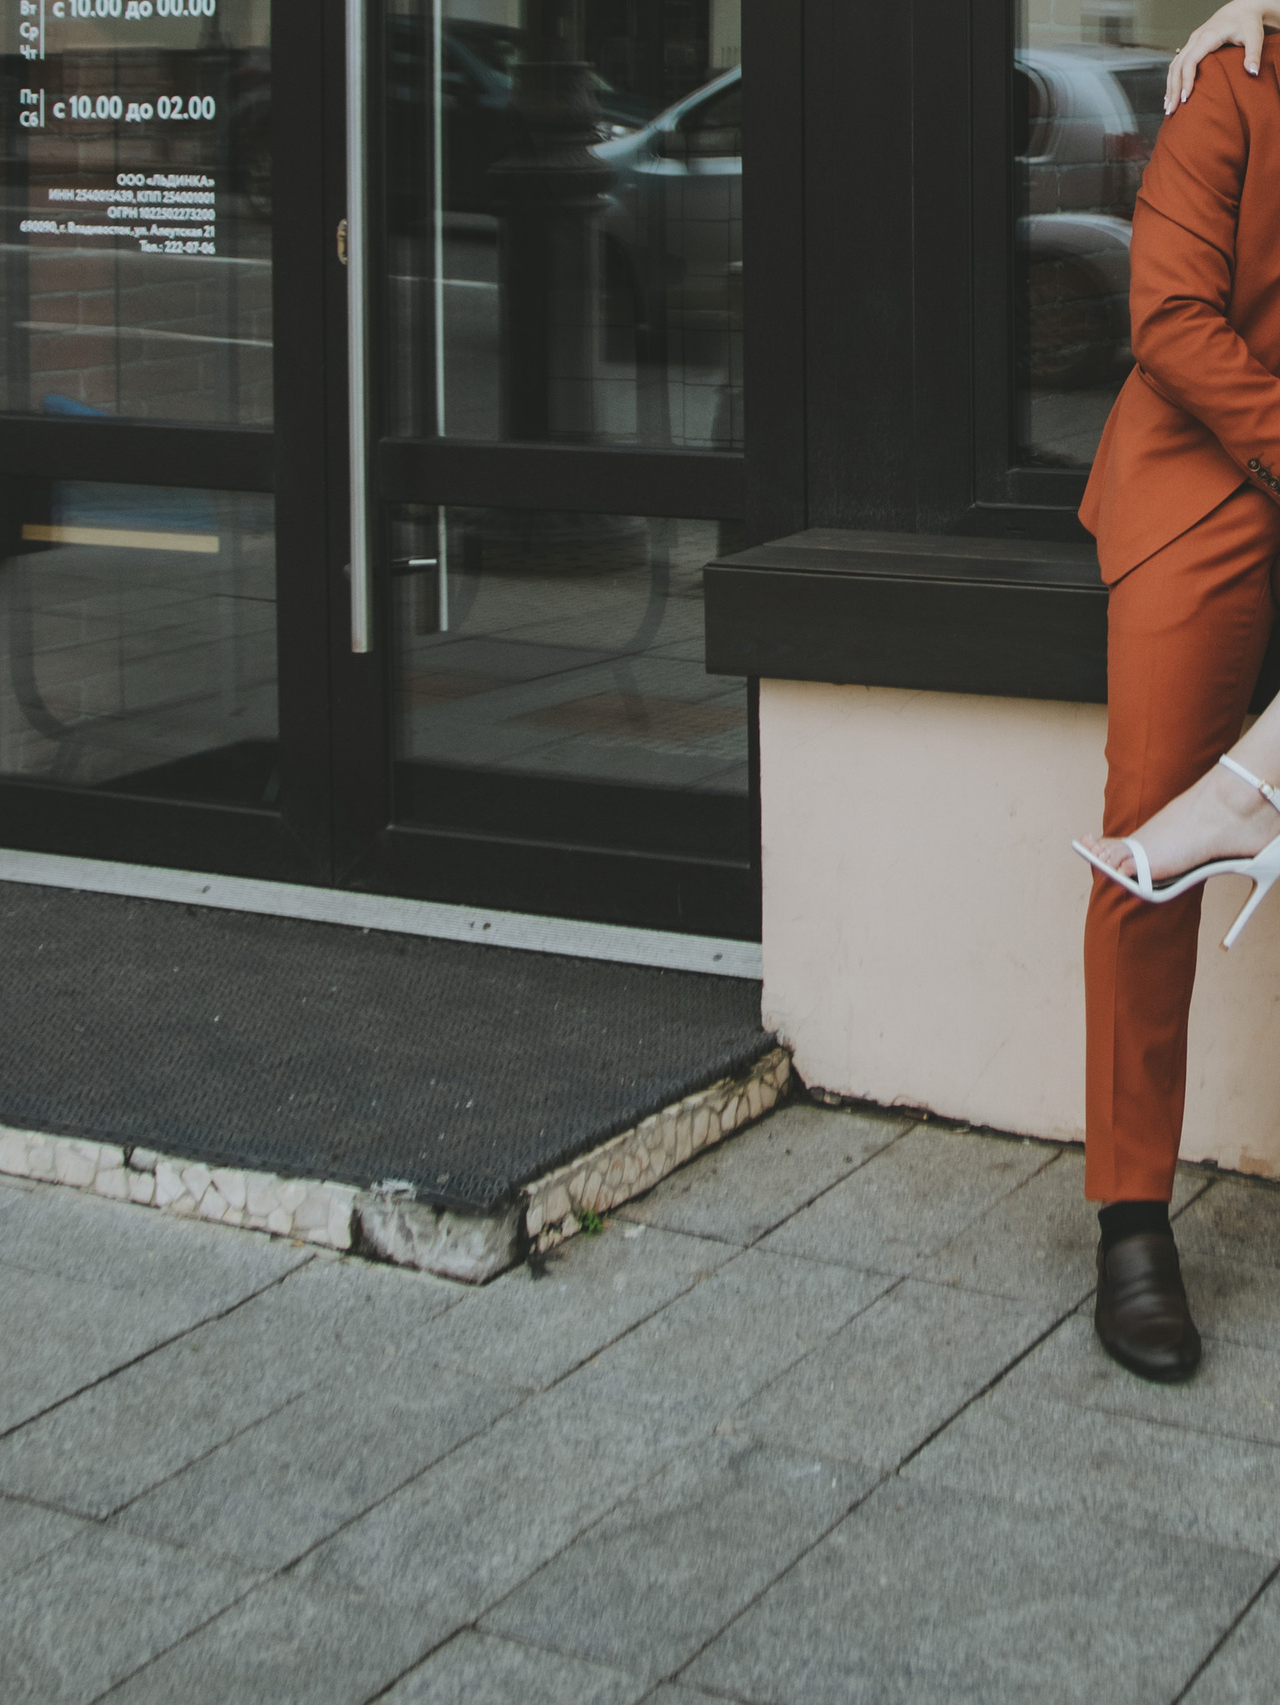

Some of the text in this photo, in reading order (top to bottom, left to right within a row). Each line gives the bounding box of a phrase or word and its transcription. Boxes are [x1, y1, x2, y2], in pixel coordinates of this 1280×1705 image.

[20, 0, 37, 16] Вт
[52, 1, 65, 18] с
[125, 1, 153, 20] до
[19, 22, 39, 41] Ср
[20, 45, 38, 60] Чт
[20, 88, 39, 105] Пт
[53, 95, 216, 123] с 10.00 до 02.00
[19, 111, 39, 128] Сб
[116, 174, 145, 187] ООО
[48, 189, 75, 202] ИНН
[136, 190, 162, 203] КПП
[107, 206, 138, 220] ОГРН
[203, 225, 216, 238] 21
